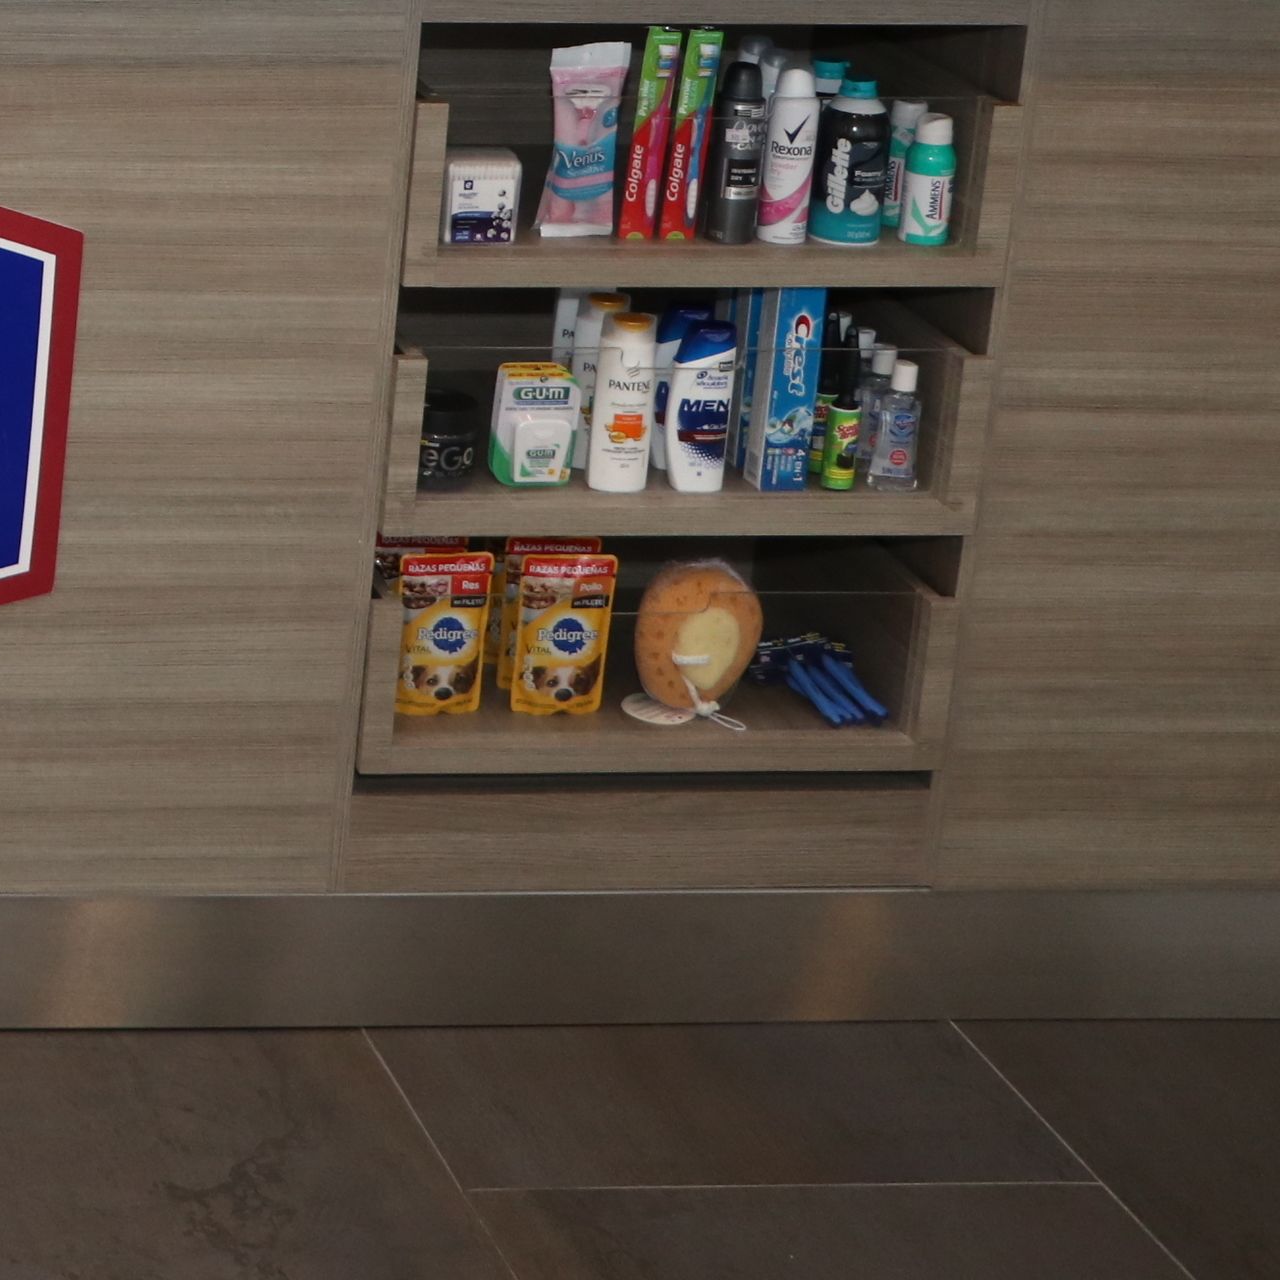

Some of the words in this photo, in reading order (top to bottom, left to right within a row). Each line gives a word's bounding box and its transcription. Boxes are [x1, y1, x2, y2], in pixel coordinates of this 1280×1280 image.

[771, 141, 813, 156] Rexona
[559, 150, 605, 169] Venus
[625, 144, 645, 202] Colgate
[666, 143, 687, 202] Colgate
[826, 138, 852, 214] Gillette
[925, 179, 941, 220] AMMENS
[788, 313, 813, 397] Crest
[683, 399, 730, 412] MEN
[408, 564, 436, 572] RAZAS
[529, 565, 559, 574] RAZAS
[560, 564, 608, 575] PEQUEÑAS
[462, 580, 480, 590] Res
[418, 627, 479, 642] Pedigree
[537, 628, 598, 643] Pedigree
